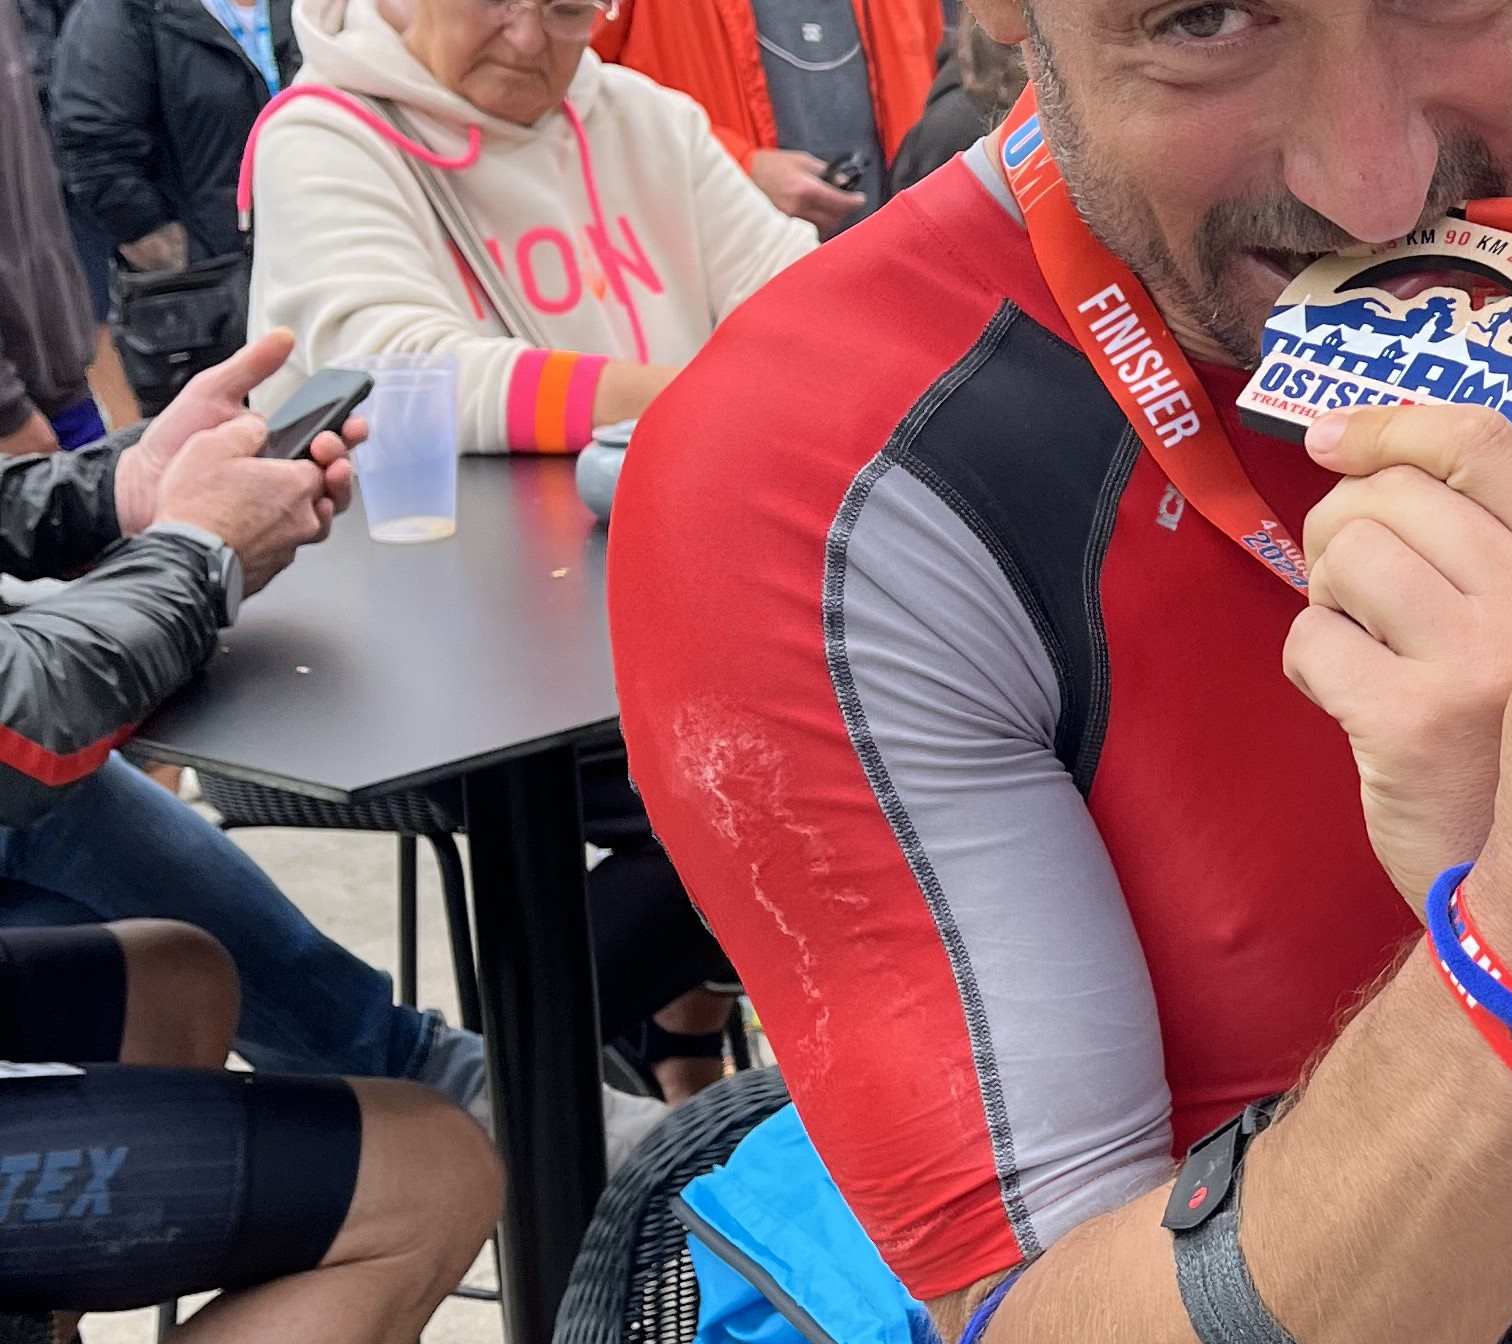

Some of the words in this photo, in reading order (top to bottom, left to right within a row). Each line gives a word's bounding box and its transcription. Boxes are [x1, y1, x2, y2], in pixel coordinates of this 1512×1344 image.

[1406, 229, 1435, 246] KM
[1443, 230, 1471, 247] 90
[1476, 234, 1509, 256] KM
[1077, 282, 1201, 449] FINISHER
